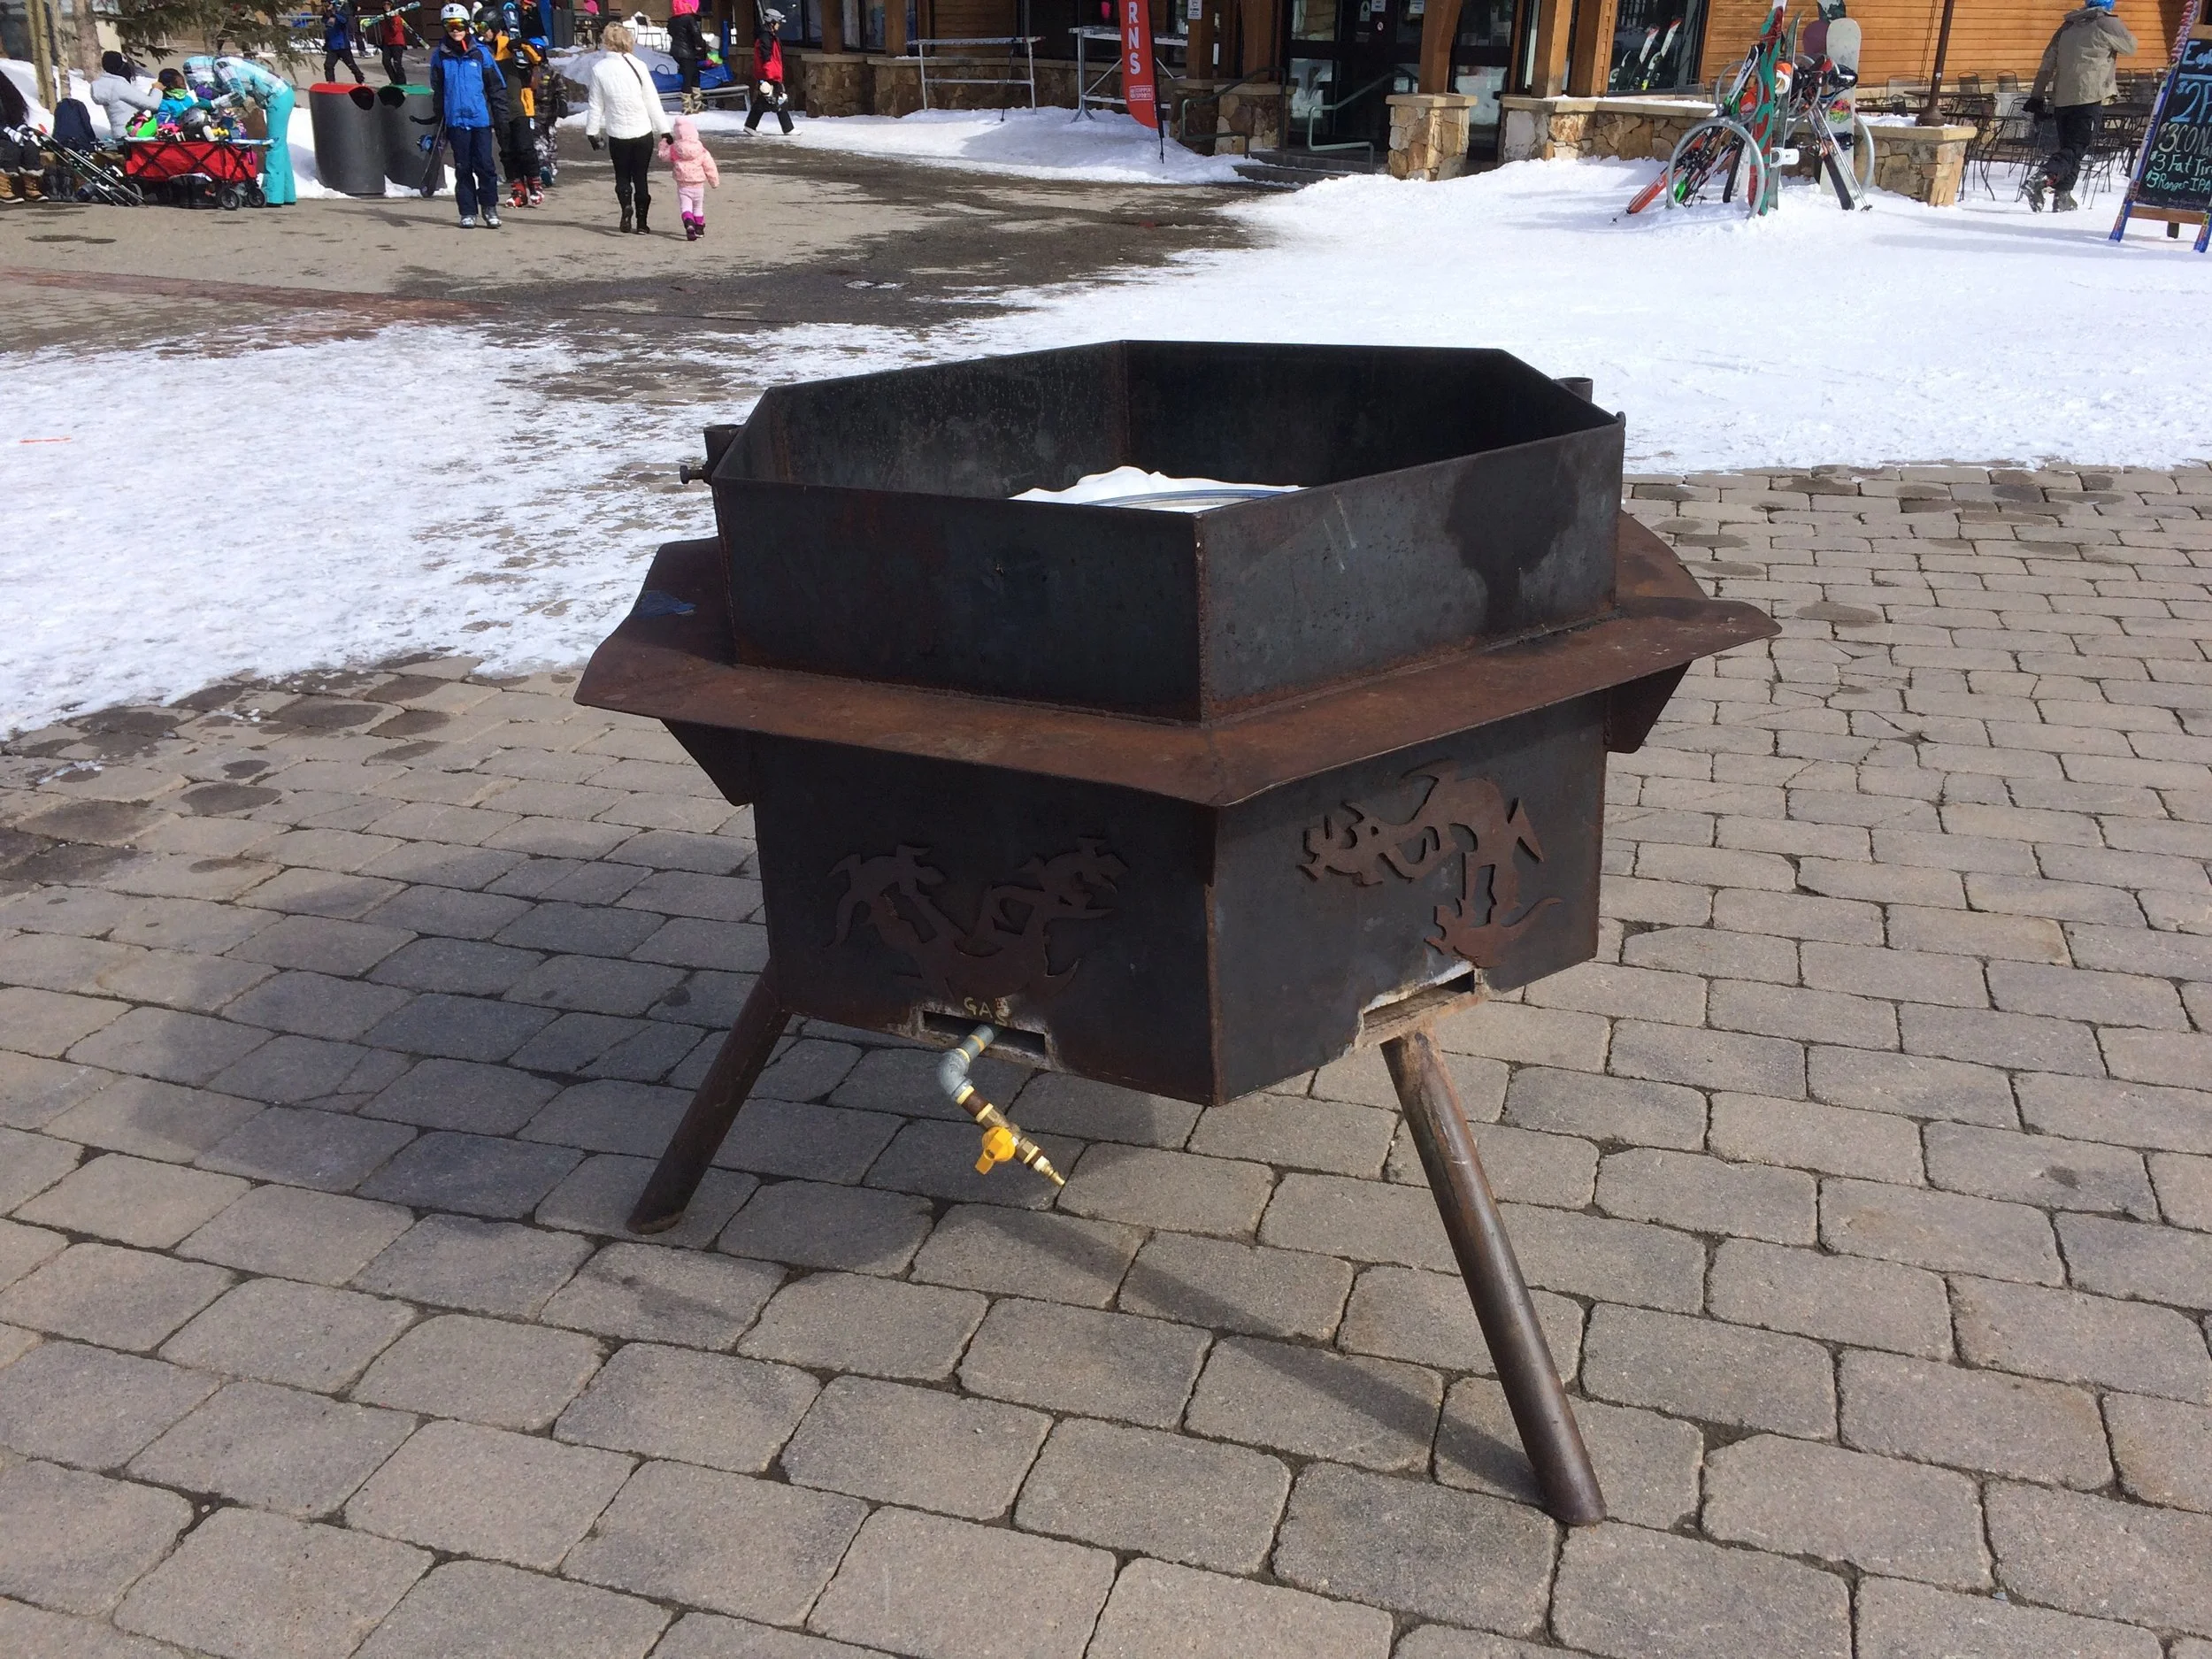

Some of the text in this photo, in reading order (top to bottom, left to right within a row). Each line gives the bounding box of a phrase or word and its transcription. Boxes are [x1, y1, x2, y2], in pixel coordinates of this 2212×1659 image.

[1127, 2, 1141, 75] RNS
[2168, 154, 2193, 173] Fat
[2189, 178, 2211, 194] IPA
